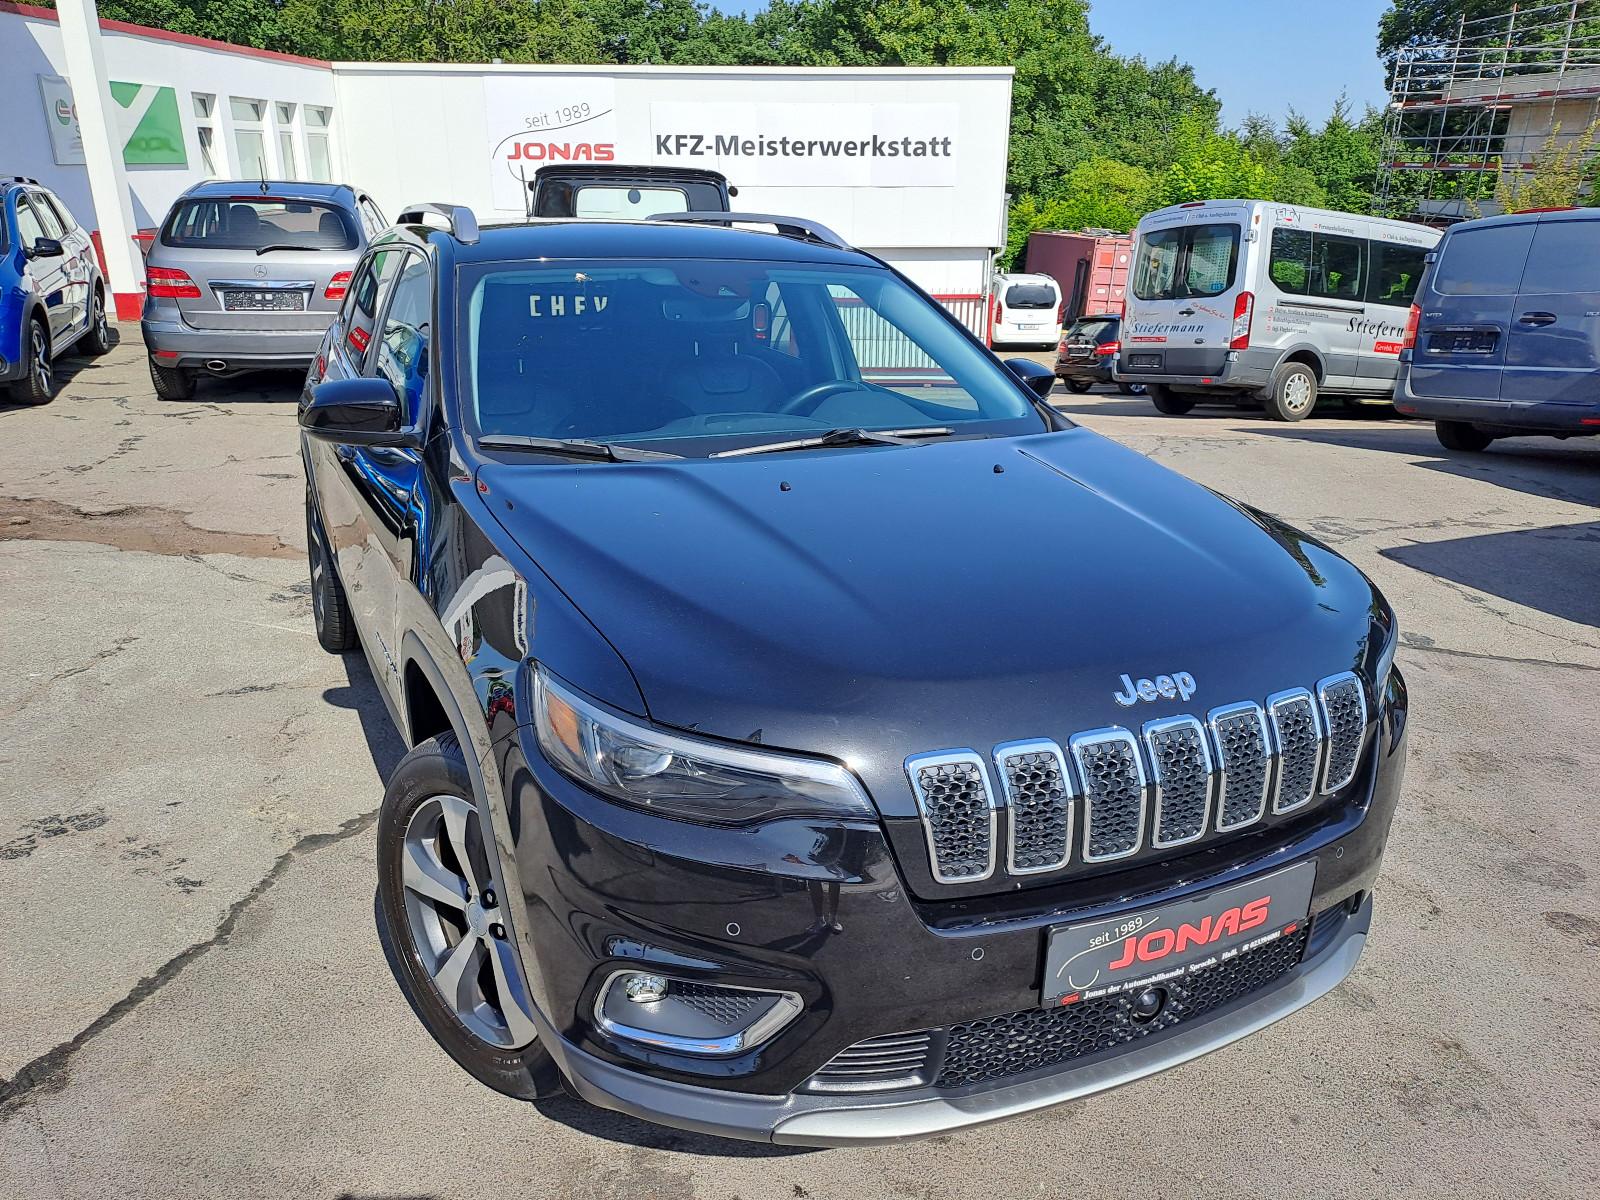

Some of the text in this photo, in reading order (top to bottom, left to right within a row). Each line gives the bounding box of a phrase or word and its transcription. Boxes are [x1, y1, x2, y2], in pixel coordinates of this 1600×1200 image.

[524, 102, 591, 128] seit 1989
[507, 142, 615, 161] JONAS
[656, 134, 951, 157] KFZ-Meisterwerkstatt
[1133, 322, 1204, 335] Stiefermann
[1113, 671, 1197, 707] Jeep
[1089, 916, 1143, 948] seit 1989
[1109, 895, 1271, 970] JONAS
[1083, 988, 1106, 1000] Jonas
[1107, 984, 1121, 994] der
[1122, 966, 1185, 990] Automobilhandel
